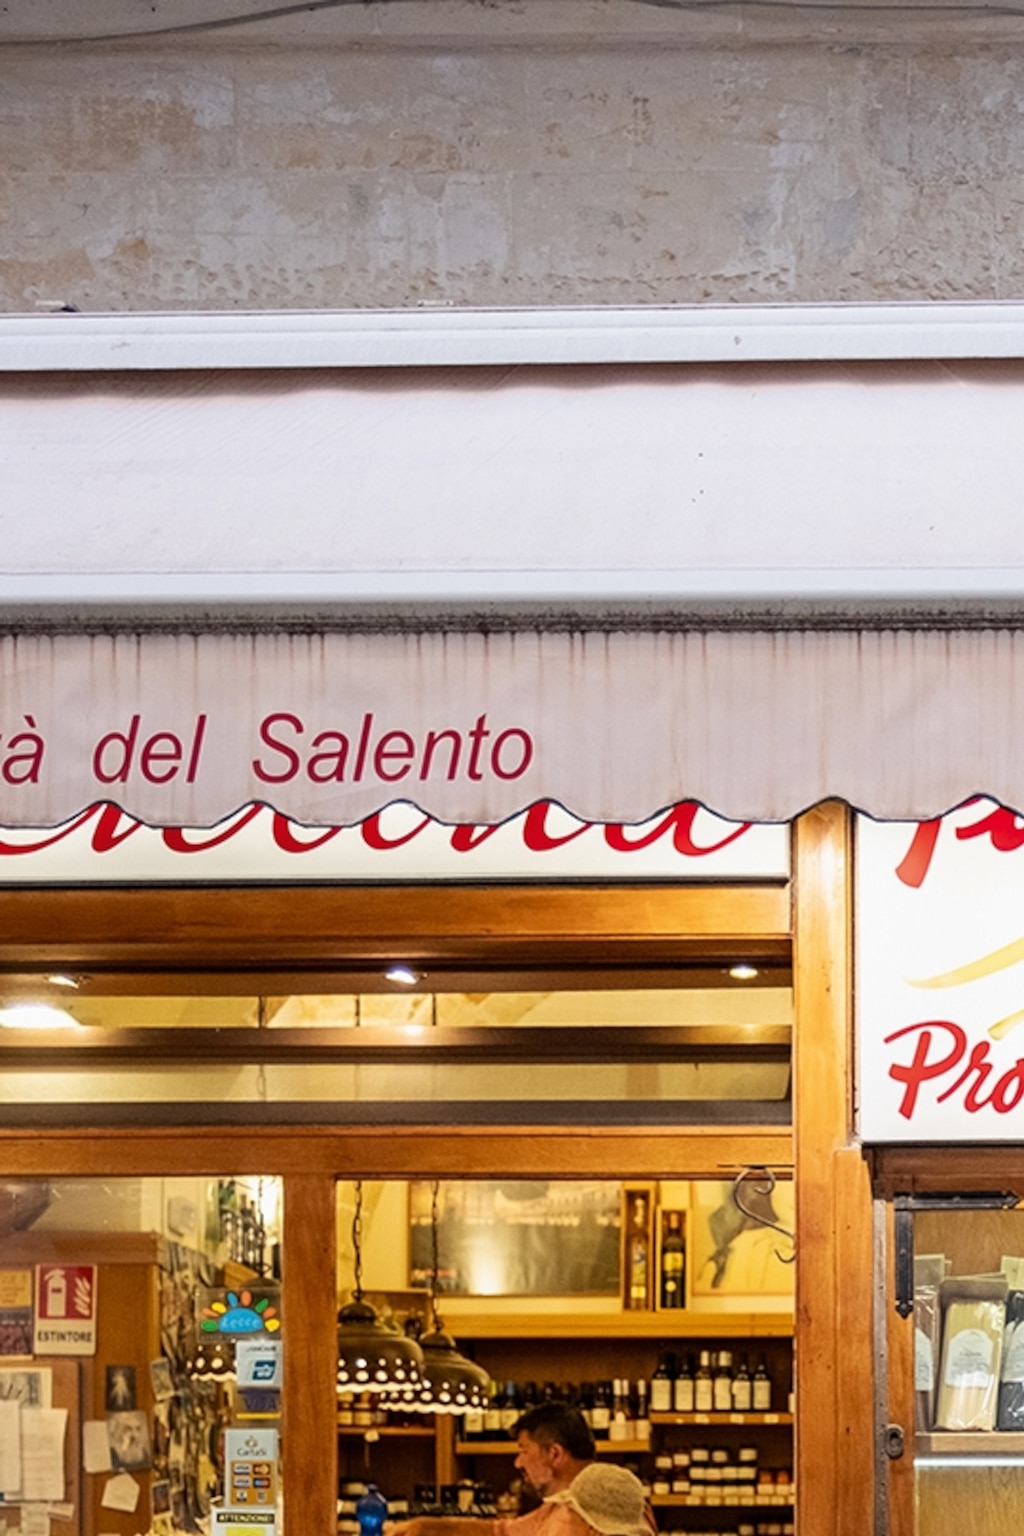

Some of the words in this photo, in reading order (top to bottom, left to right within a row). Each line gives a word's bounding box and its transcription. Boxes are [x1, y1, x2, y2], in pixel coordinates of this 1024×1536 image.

[0, 715, 45, 784] à
[94, 714, 207, 784] del
[252, 712, 534, 784] Salento
[37, 1331, 92, 1342] ESTINTORE
